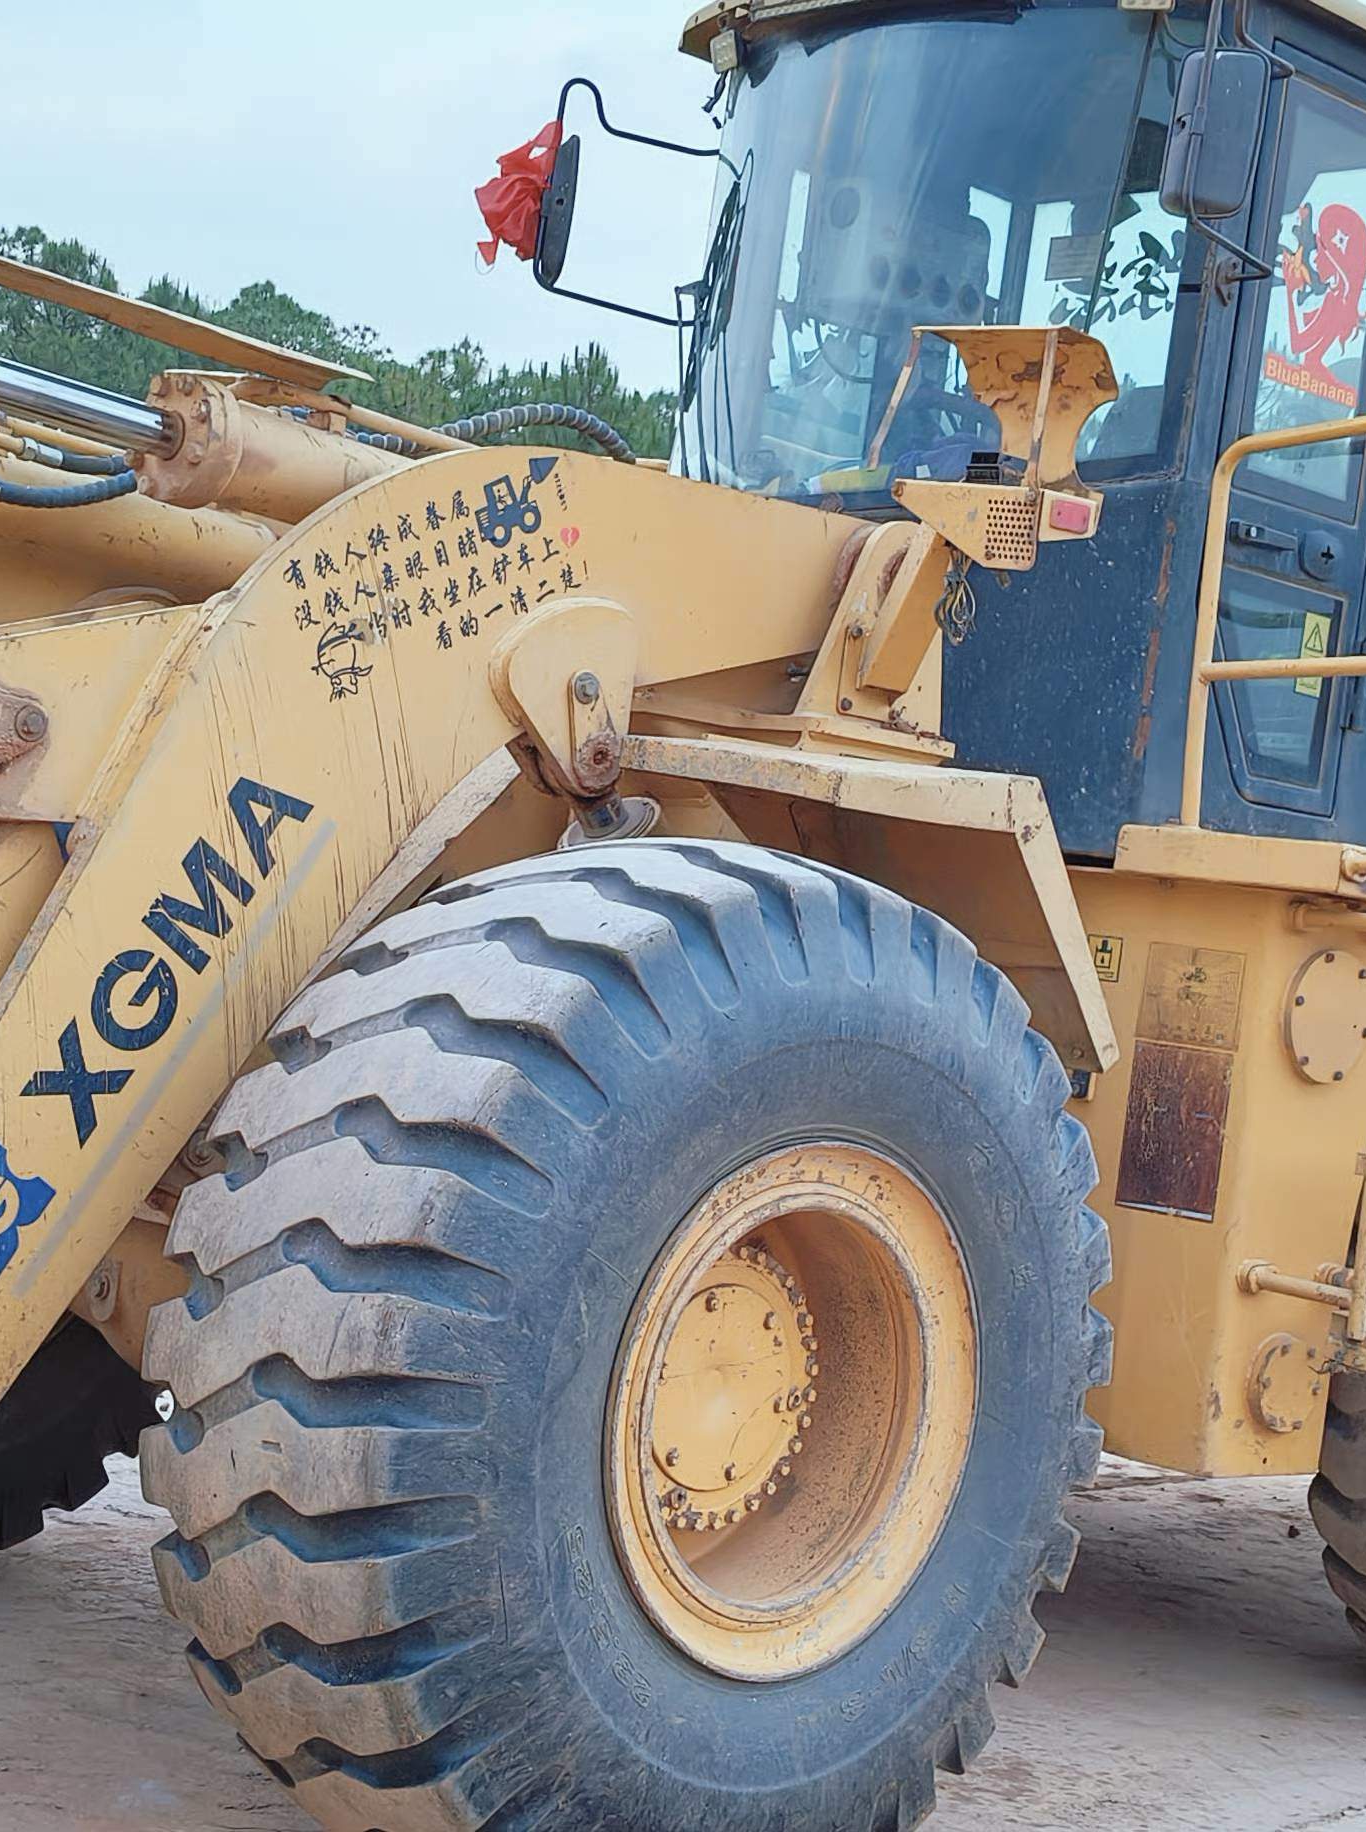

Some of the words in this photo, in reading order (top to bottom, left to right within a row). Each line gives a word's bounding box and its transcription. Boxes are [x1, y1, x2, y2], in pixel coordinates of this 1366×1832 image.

[1265, 357, 1355, 407] BlueBanana
[283, 490, 471, 591] 有钱人终成眷属
[19, 776, 315, 1149] XGMA
